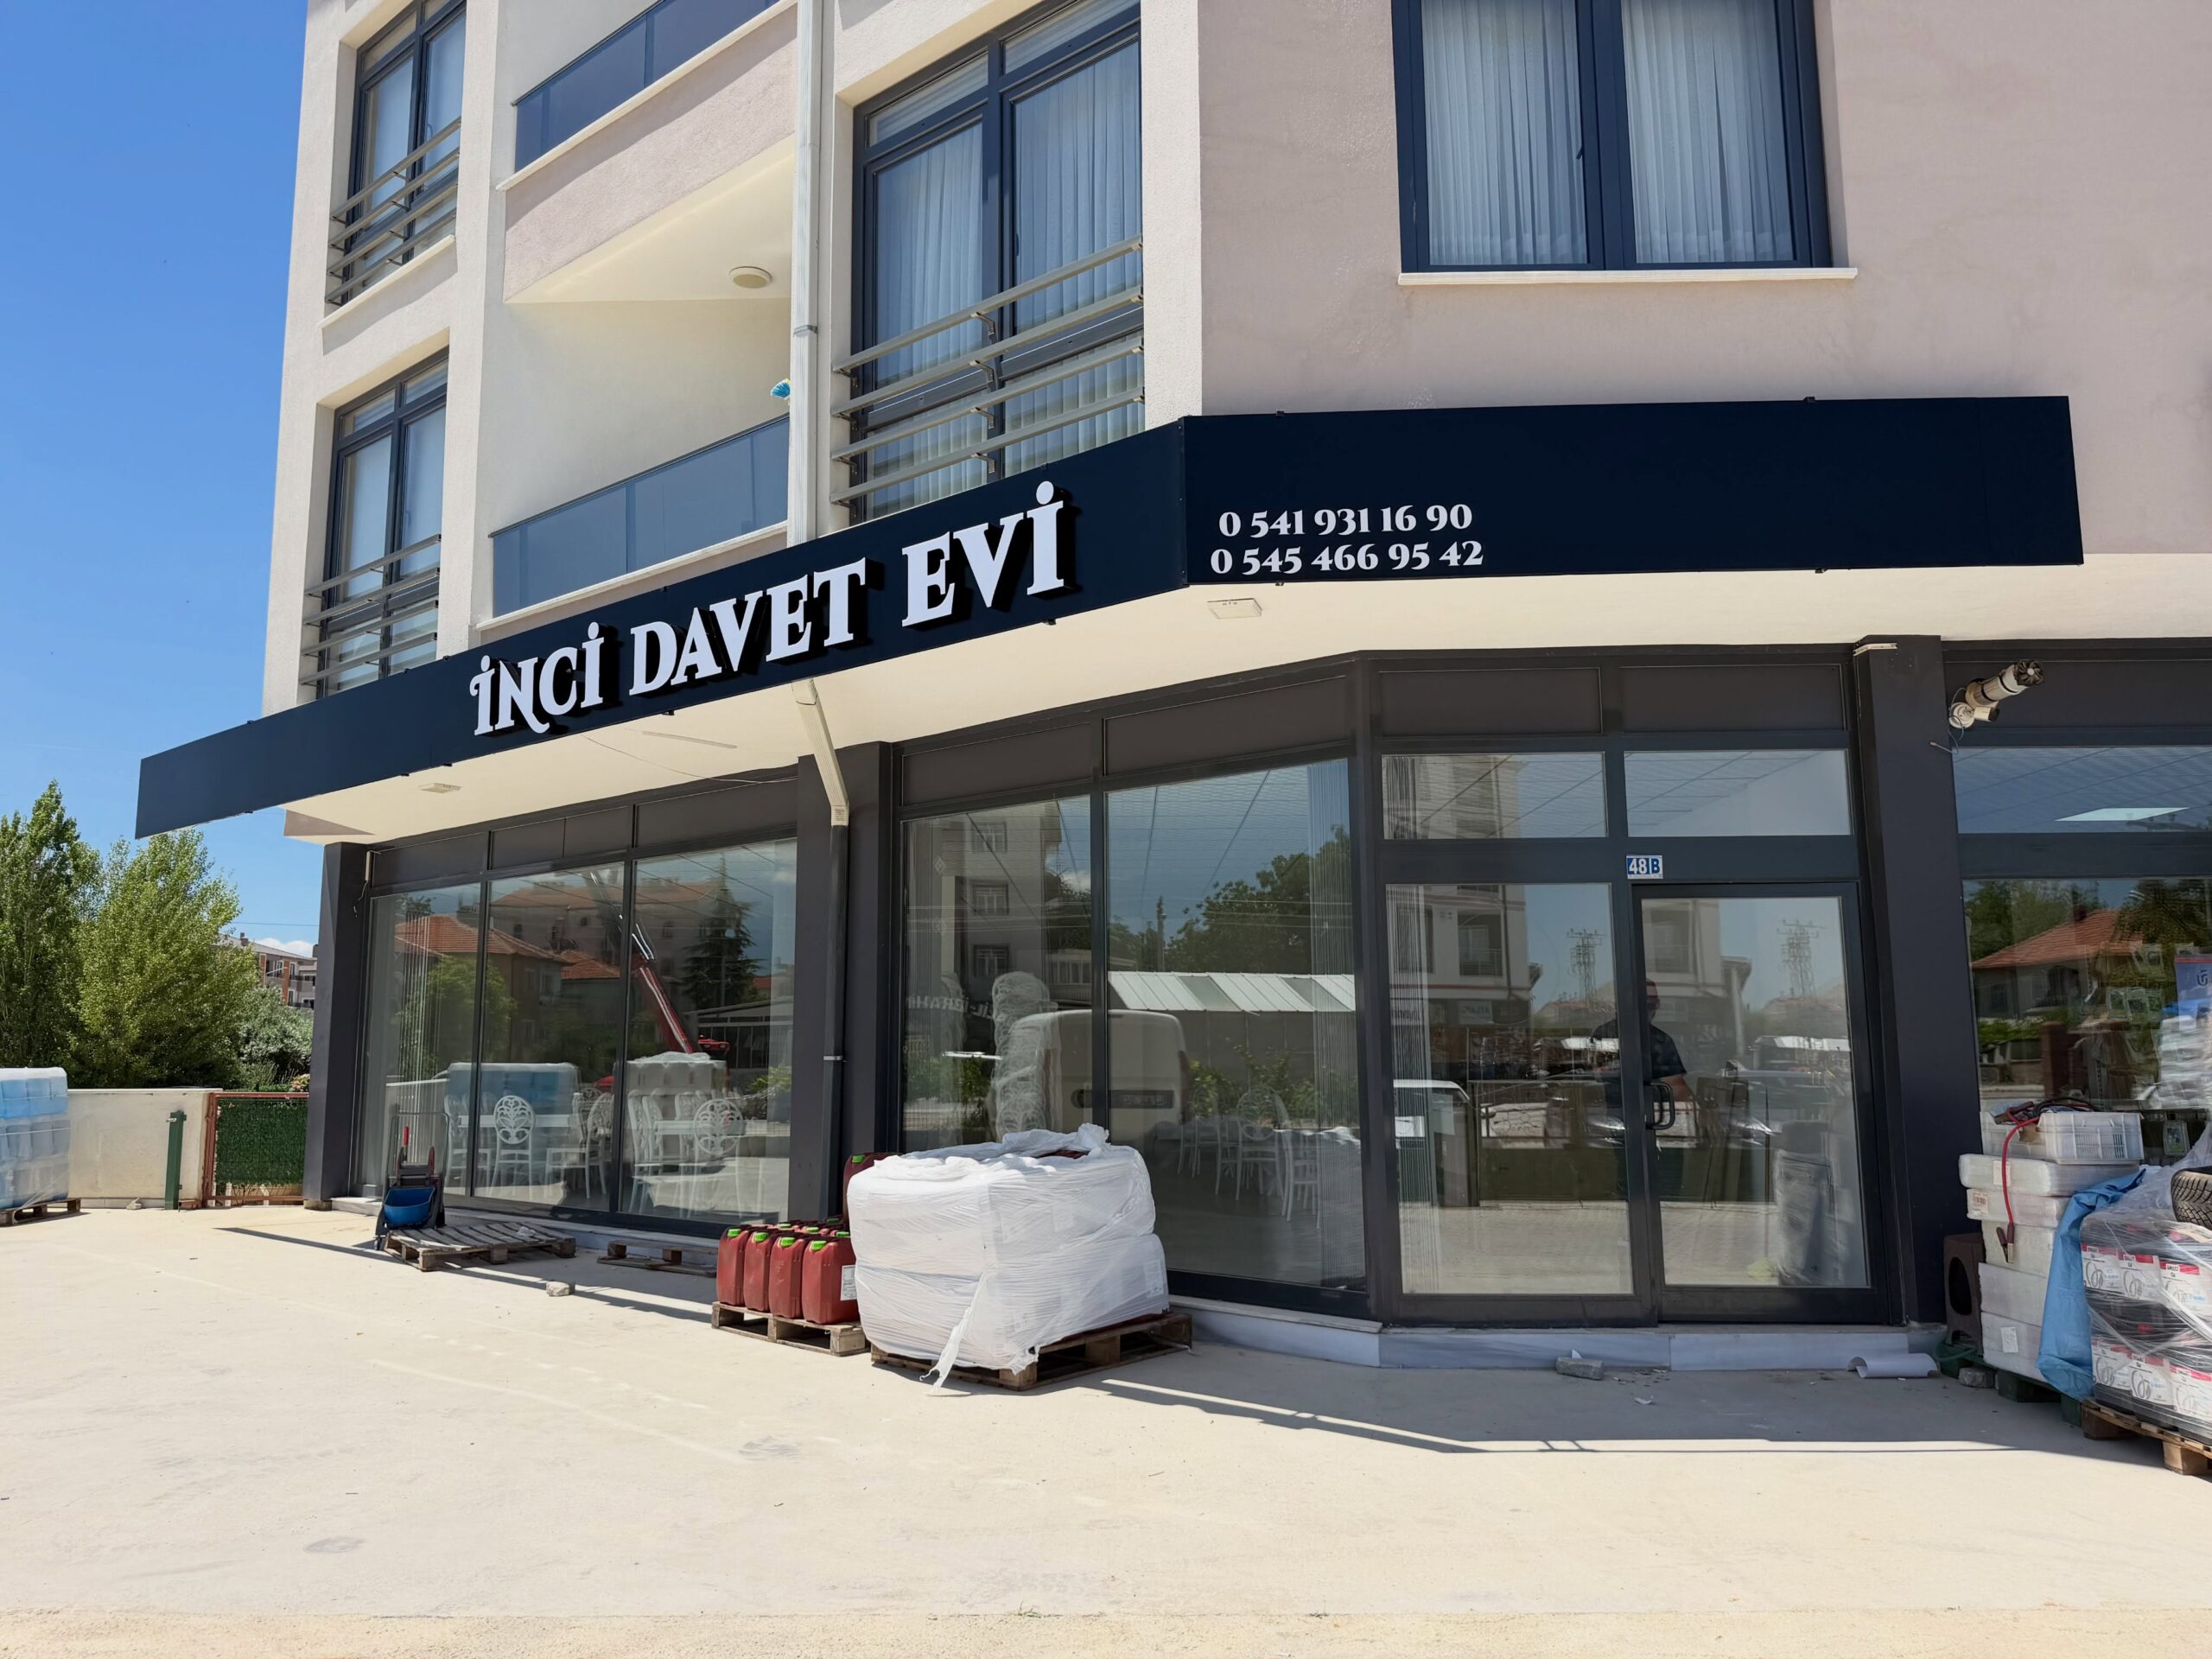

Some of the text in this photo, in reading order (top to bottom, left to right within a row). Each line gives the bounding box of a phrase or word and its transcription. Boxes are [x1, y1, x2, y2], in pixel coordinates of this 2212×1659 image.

[1218, 504, 1472, 538] 0 541 931 16 90
[1211, 540, 1484, 575] 0 545 466 95 42
[469, 480, 1065, 734] İNCİ DAVET EVİ
